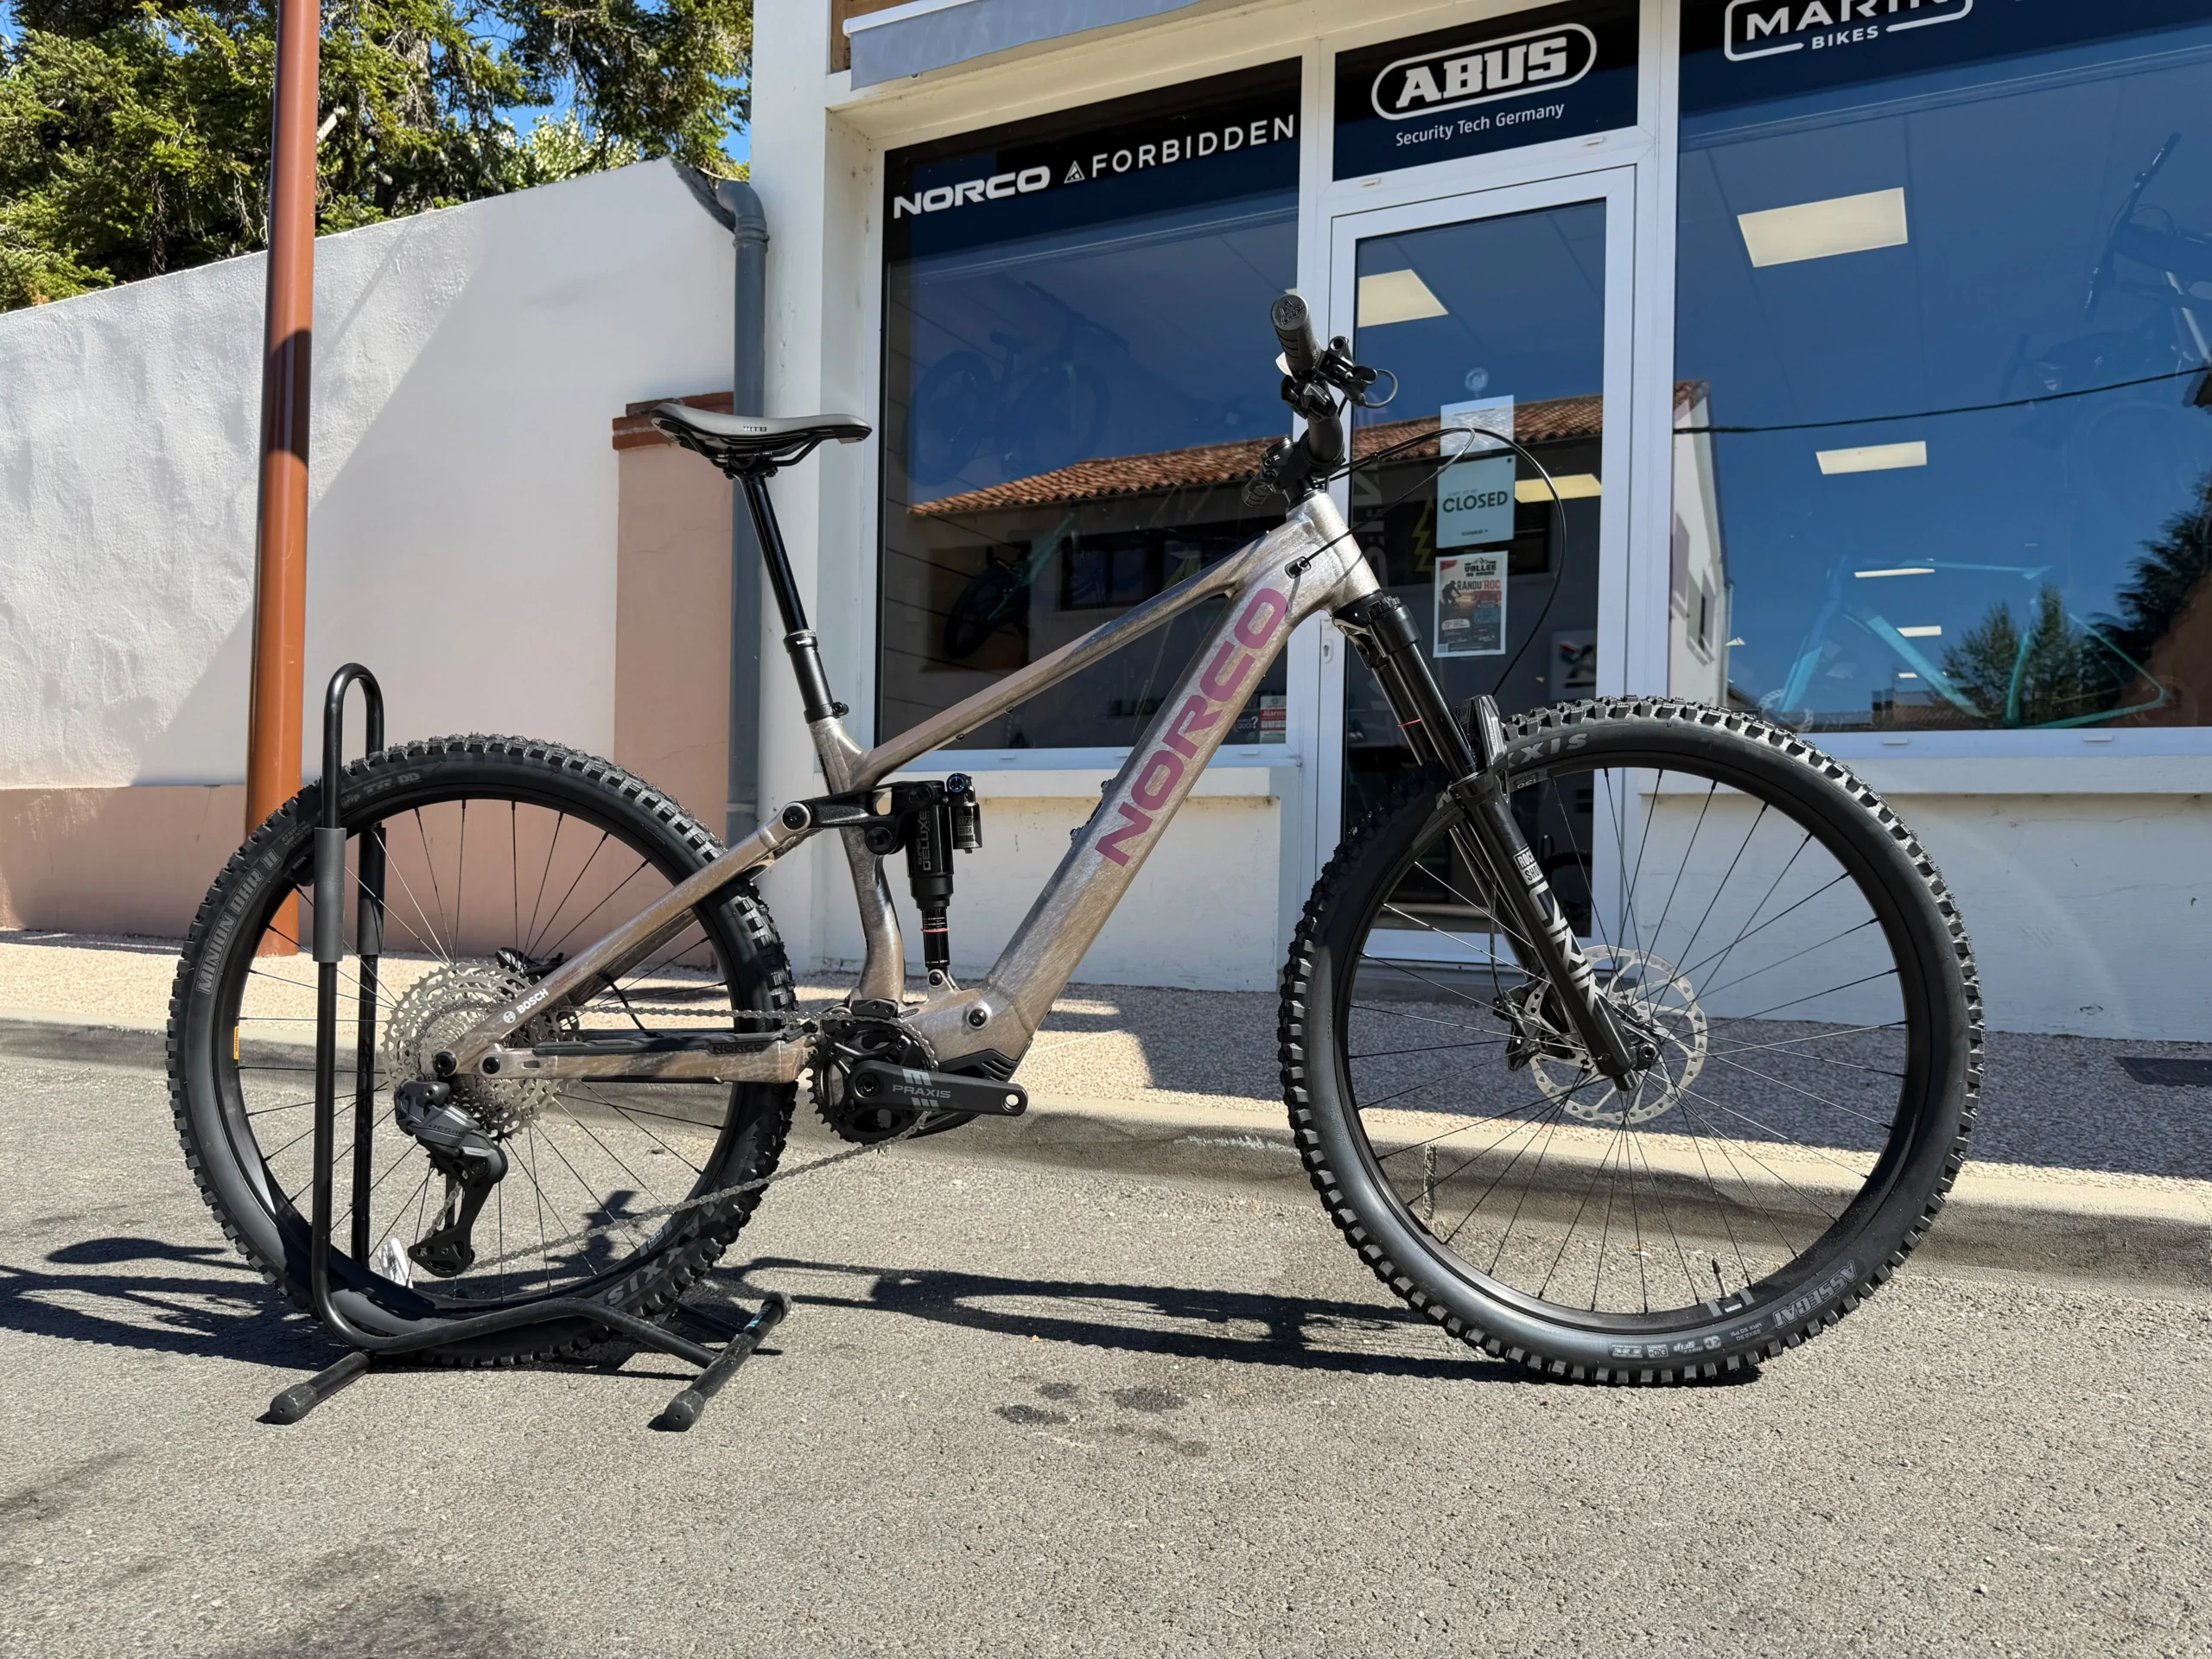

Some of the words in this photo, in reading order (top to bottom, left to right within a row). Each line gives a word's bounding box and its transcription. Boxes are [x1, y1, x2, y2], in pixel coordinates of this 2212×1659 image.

[1812, 26, 1879, 49] BIKES
[1395, 36, 1567, 110] ABUS
[1092, 114, 1294, 178] FORBIDDEN
[1395, 124, 1453, 147] Security
[1458, 114, 1491, 134] Tech
[1496, 102, 1565, 130] Germany
[893, 165, 1050, 219] NORCO
[1442, 491, 1508, 513] CLOSED
[1095, 588, 1287, 867] NORCO
[918, 810, 931, 871] DELUXE
[197, 912, 236, 994] MINION
[228, 868, 264, 914] DHR
[516, 988, 549, 1014] BOSCH
[713, 1043, 765, 1055] NORCO
[893, 1084, 951, 1098] PRAXIS
[1773, 1260, 1858, 1329] ASSEGAI
